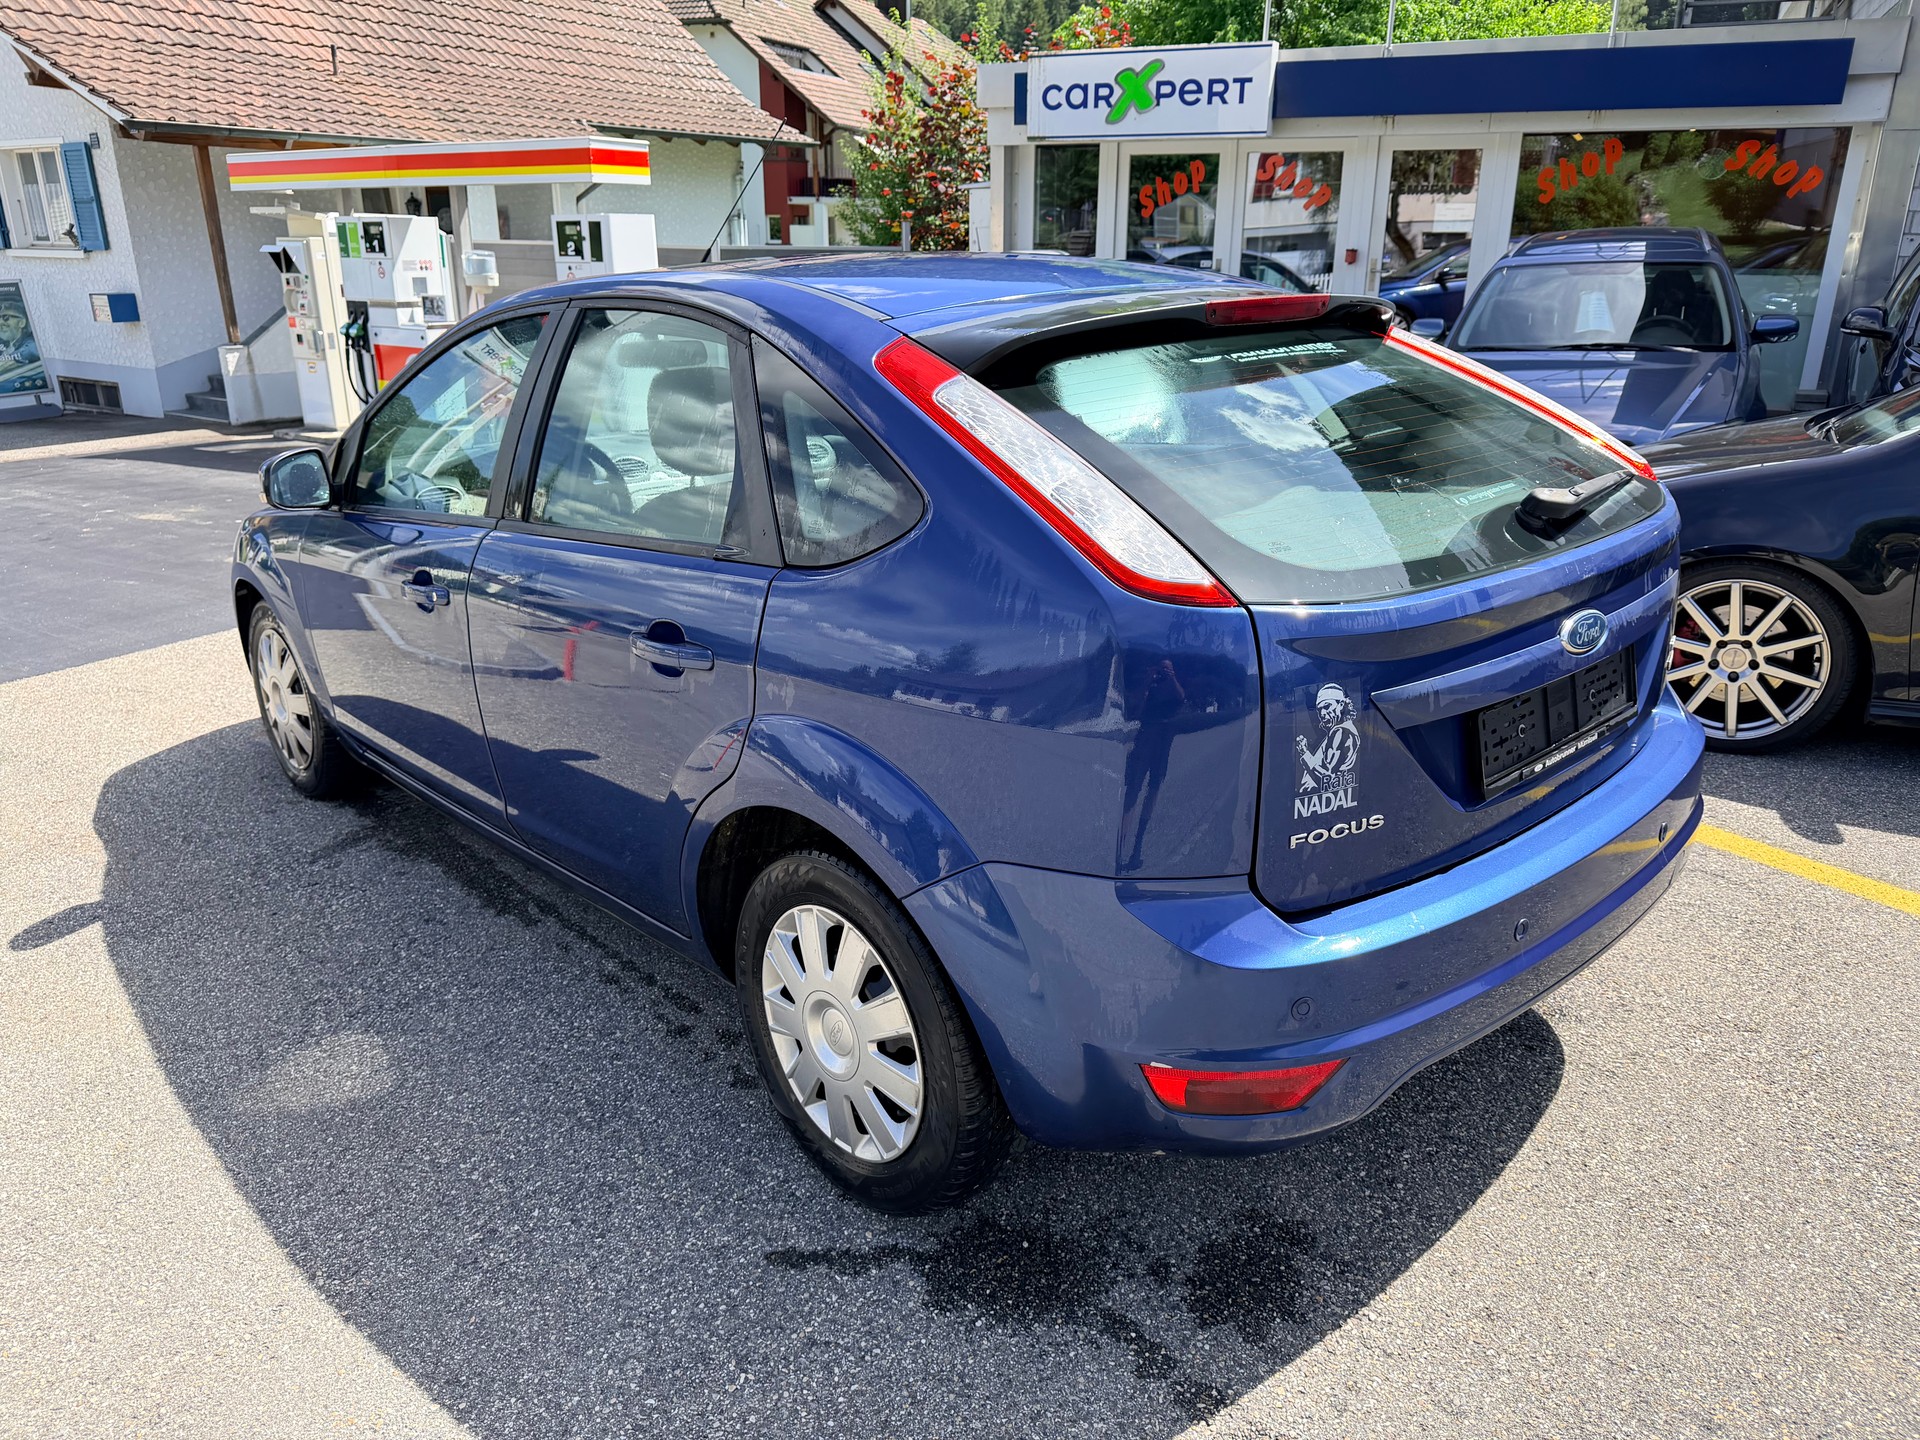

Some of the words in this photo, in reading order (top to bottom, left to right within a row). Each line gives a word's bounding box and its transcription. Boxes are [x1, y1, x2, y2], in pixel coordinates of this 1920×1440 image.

[566, 241, 576, 256] 2
[1576, 618, 1600, 645] Ford
[1321, 771, 1356, 792] Rafa
[1294, 788, 1358, 820] NADAL
[1289, 814, 1385, 849] FOCUS
